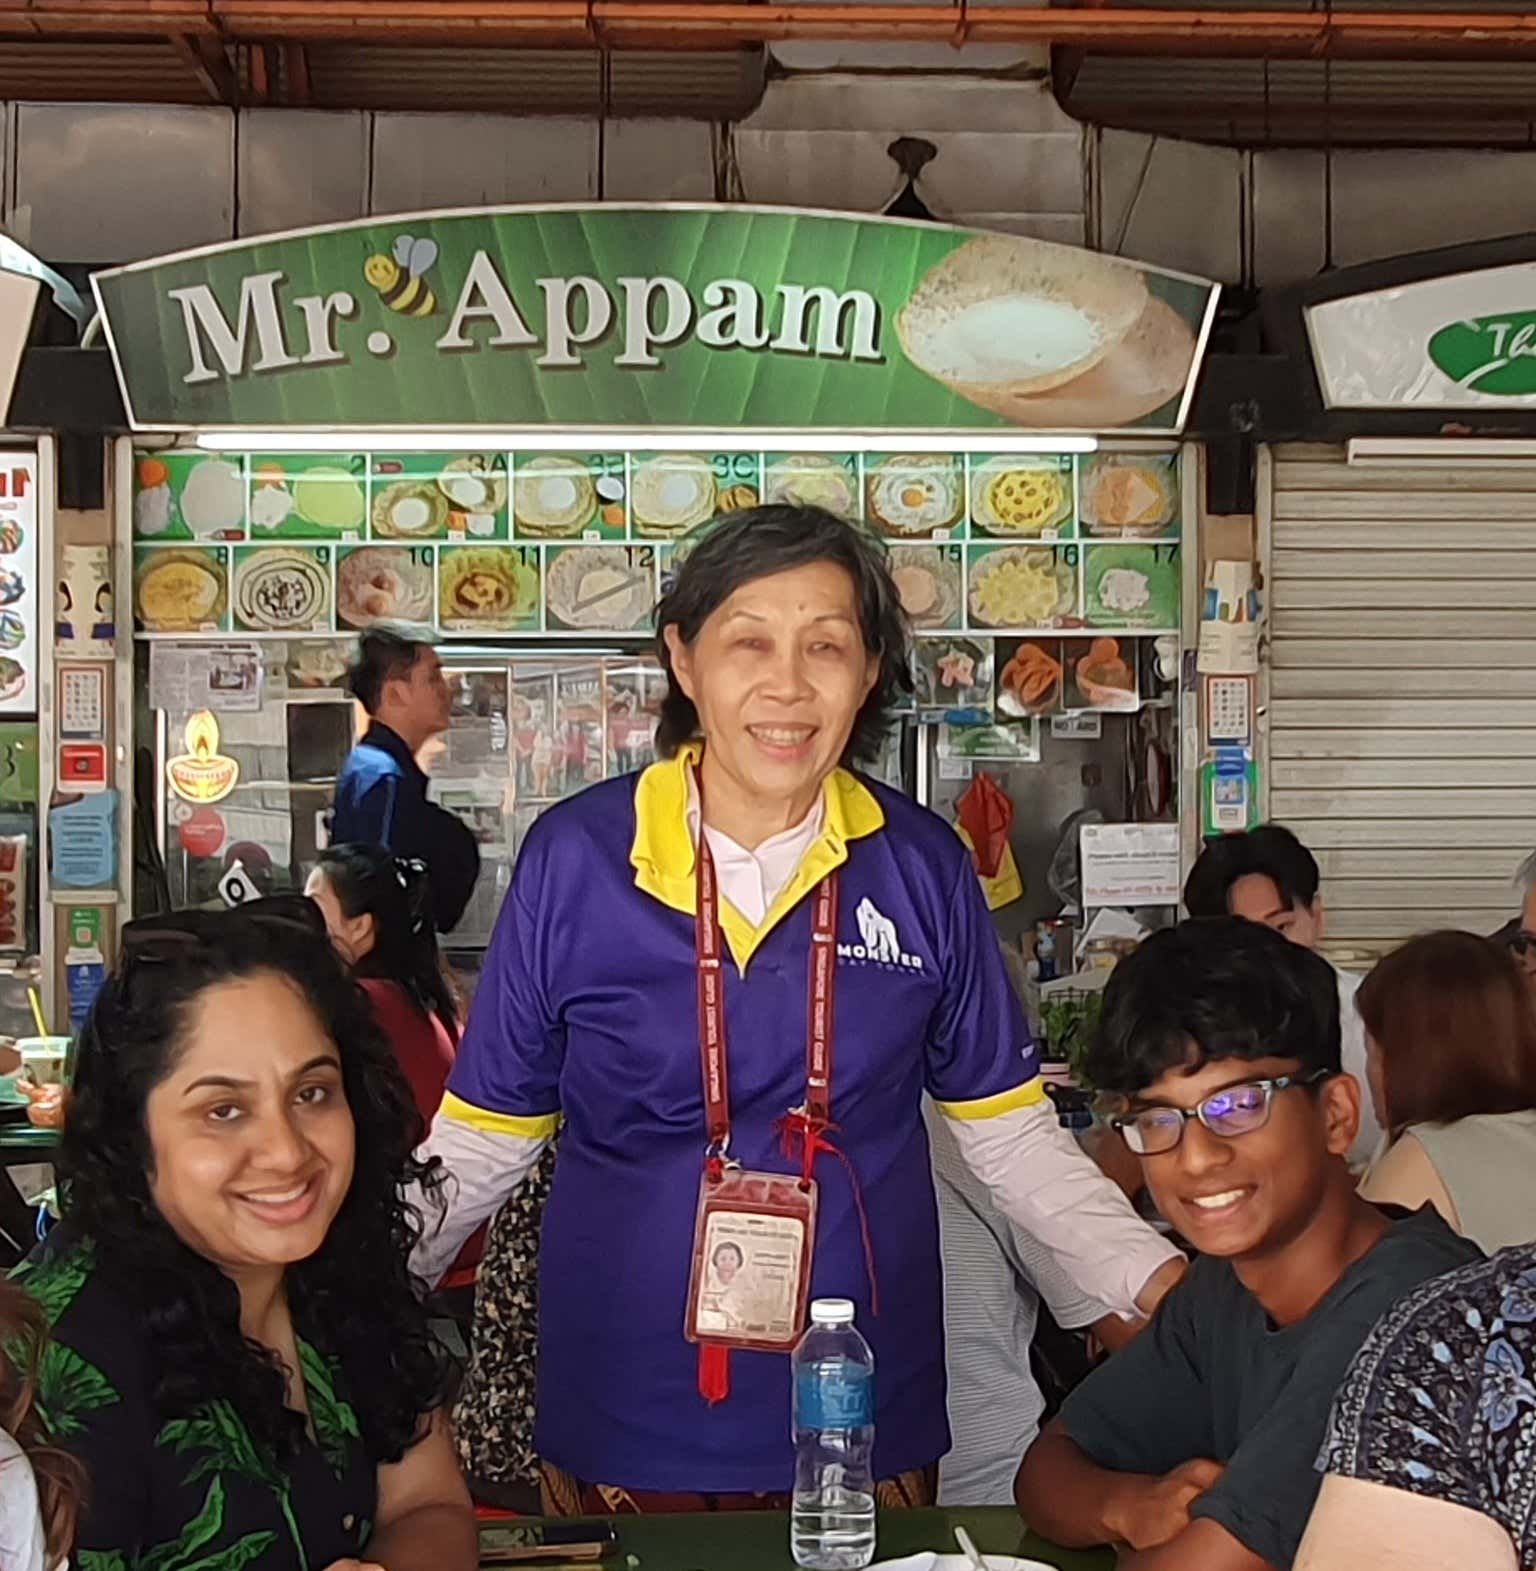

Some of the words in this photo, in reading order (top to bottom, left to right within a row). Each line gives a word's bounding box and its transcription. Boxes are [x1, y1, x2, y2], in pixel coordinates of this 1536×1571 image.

[167, 270, 394, 384] Mr.
[436, 248, 885, 368] Appam
[350, 454, 366, 474] 2
[467, 453, 508, 473] 3A
[713, 453, 755, 478] 3C
[216, 545, 228, 566] 8
[315, 545, 330, 566] 9
[407, 545, 435, 567] 10
[517, 545, 541, 567] 11
[624, 545, 654, 568] 12
[936, 544, 962, 562] 15
[1050, 545, 1078, 567] 16
[1152, 543, 1178, 564] 17
[815, 946, 828, 999] SINGAPORE
[704, 973, 716, 1004] GUIDE
[705, 1005, 718, 1045] TOURIST
[814, 1002, 826, 1039] TOURIST
[813, 1042, 824, 1071] GUIDE
[707, 1046, 721, 1103] SINGAPORE
